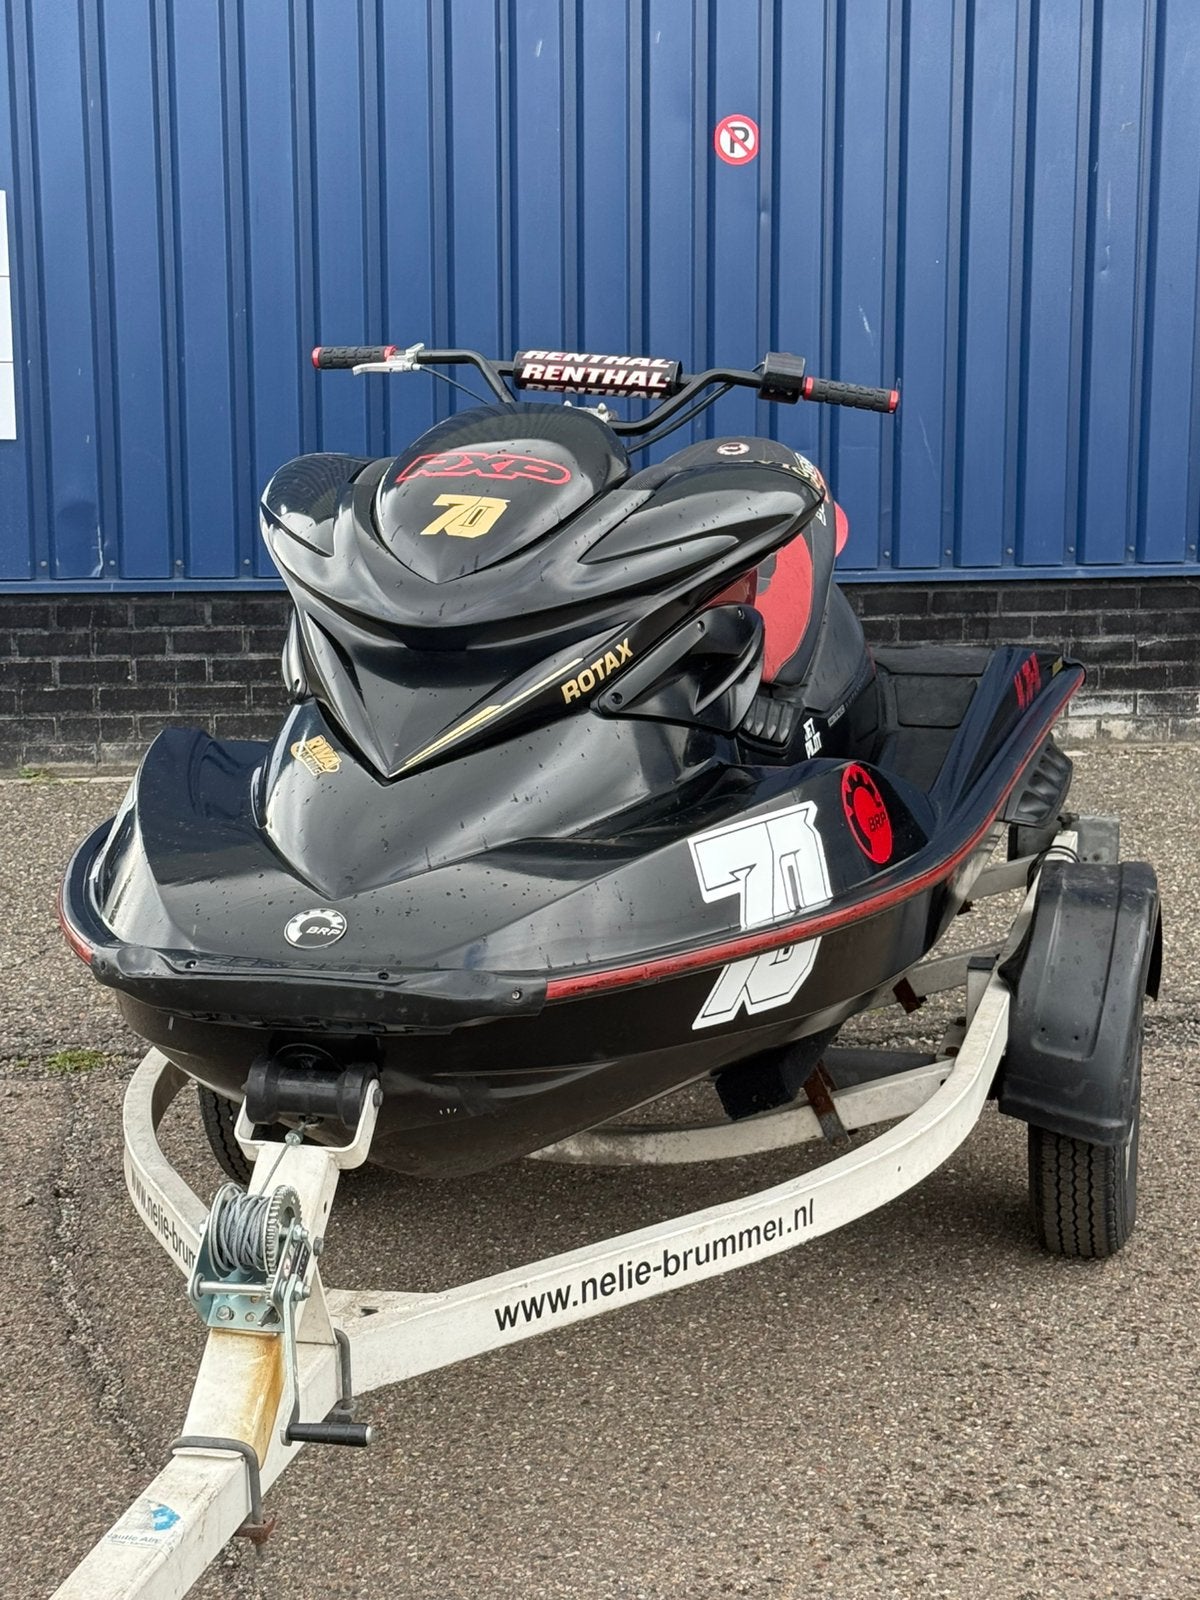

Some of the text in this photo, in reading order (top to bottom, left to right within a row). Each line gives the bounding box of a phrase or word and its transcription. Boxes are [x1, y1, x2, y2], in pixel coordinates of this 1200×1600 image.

[520, 363, 668, 388] RENTHAL
[522, 350, 671, 368] RENTHAL
[395, 452, 571, 485] RXP
[420, 494, 511, 539] 70
[560, 638, 634, 705] ROTAX
[305, 734, 341, 769] RIVA
[867, 813, 887, 833] BRP
[306, 926, 341, 936] BRP
[494, 1198, 814, 1332] www.nelie-brummel.nl
